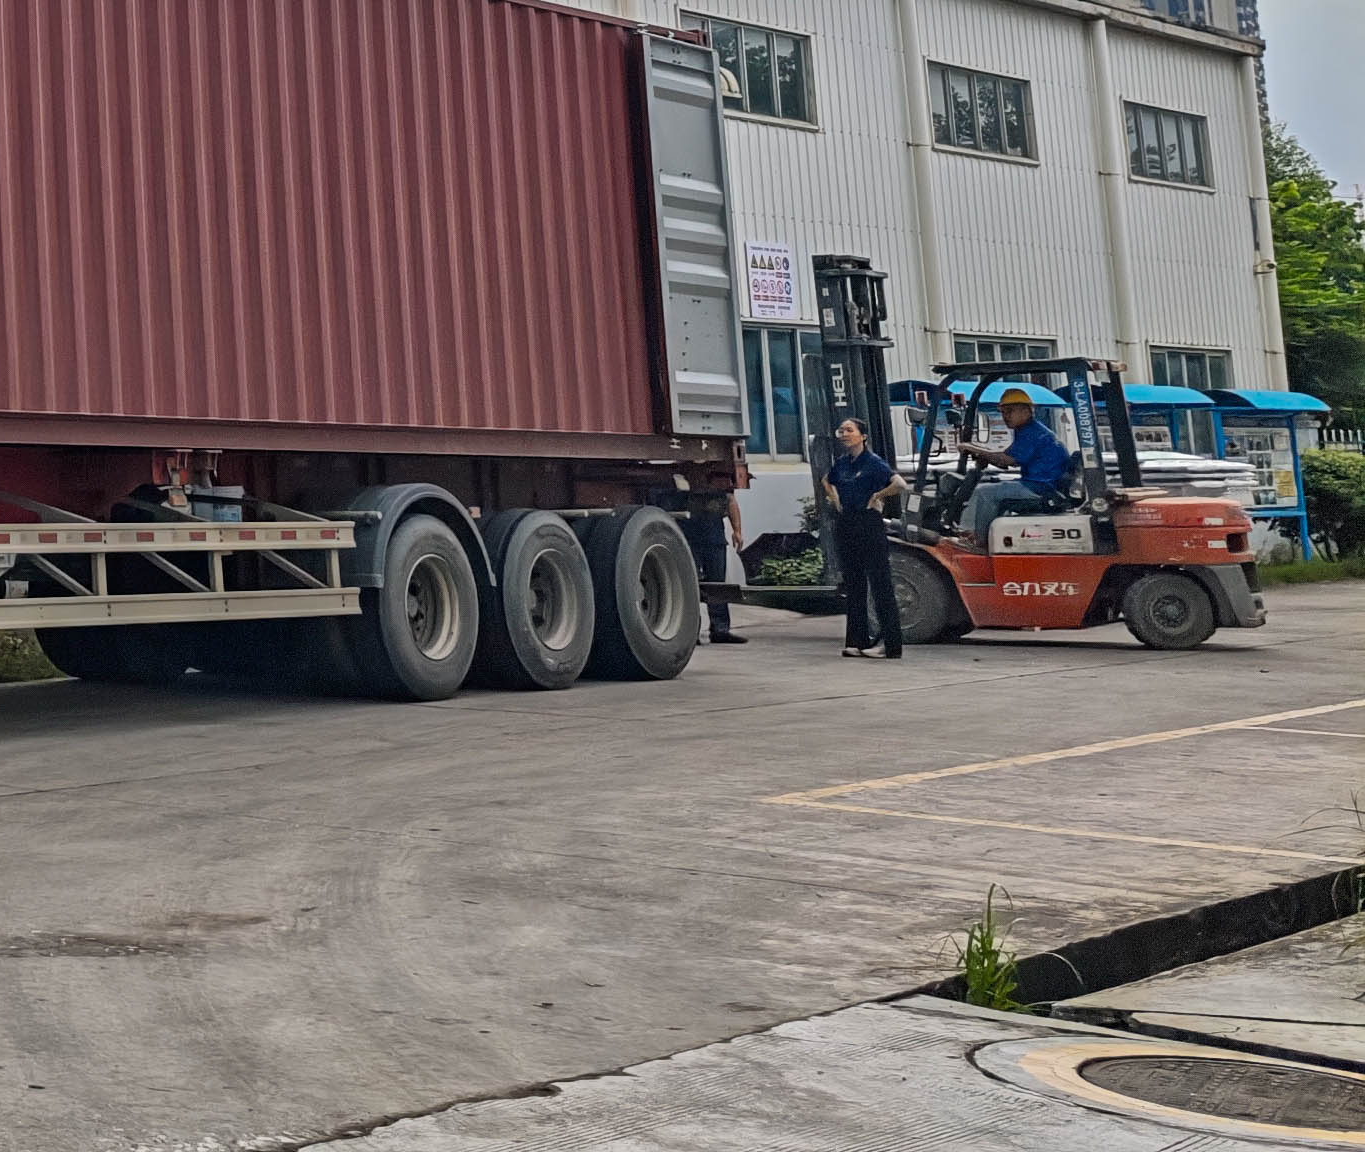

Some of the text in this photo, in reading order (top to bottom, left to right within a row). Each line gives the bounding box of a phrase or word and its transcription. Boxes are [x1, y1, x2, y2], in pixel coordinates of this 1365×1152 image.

[830, 363, 848, 407] HELI
[1051, 528, 1082, 540] 30
[1003, 581, 1079, 596] 合力叉车
